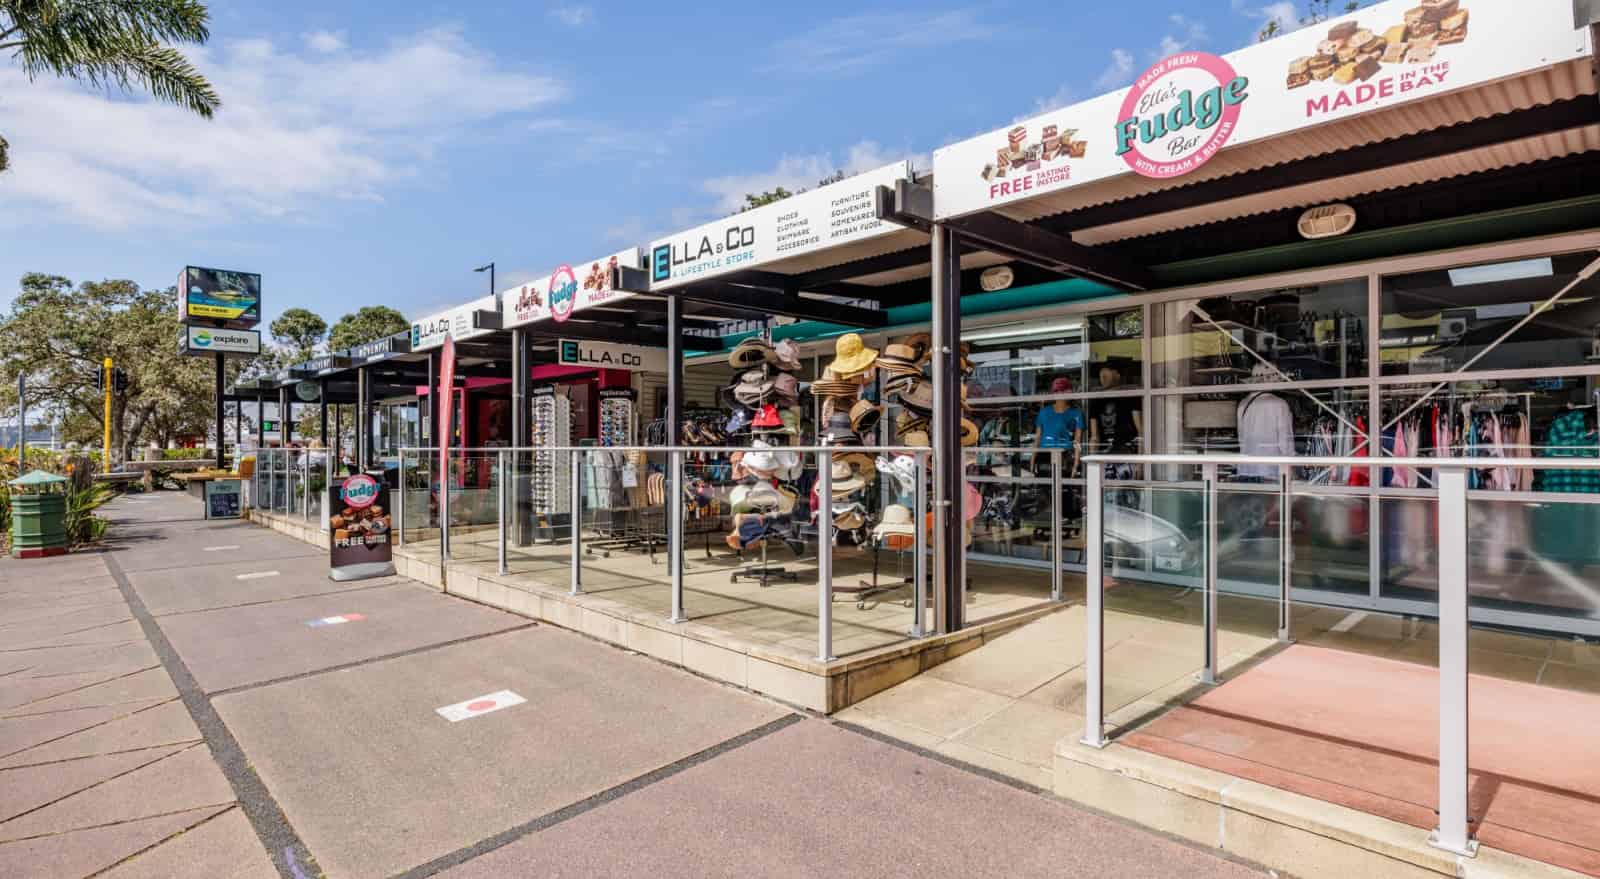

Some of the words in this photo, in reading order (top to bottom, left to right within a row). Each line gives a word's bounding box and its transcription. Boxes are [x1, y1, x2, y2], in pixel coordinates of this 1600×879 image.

[1137, 65, 1165, 89] MADE
[1167, 55, 1199, 68] FRESH
[1400, 70, 1416, 81] IN
[1423, 61, 1449, 75] THE
[1400, 70, 1449, 92] BAY
[1139, 80, 1177, 114] Ella's
[1306, 76, 1394, 117] MADE
[1114, 76, 1249, 156] Fudge
[1135, 159, 1157, 173] WITH
[1158, 160, 1193, 174] CREAM
[1204, 121, 1233, 156] BUTTER
[1167, 135, 1201, 156] Bar
[1036, 165, 1071, 179] TASTING
[1036, 173, 1071, 187] INSTORE
[990, 175, 1033, 199] FREE
[831, 190, 871, 207] FURNITURE
[777, 211, 798, 223] SHOES
[831, 201, 872, 217] SOUVENIRS
[831, 210, 875, 226] HOMEWARES
[777, 218, 809, 233] CLOTHING
[831, 226, 858, 238] ARTISAN
[653, 236, 714, 282] ELLA
[716, 243, 724, 253] &
[680, 258, 721, 276] LIFESTYLE
[726, 250, 754, 265] STORE
[213, 334, 249, 345] explore
[562, 341, 613, 364] ELLA
[338, 482, 382, 500] Fudge
[335, 536, 364, 548] FREE
